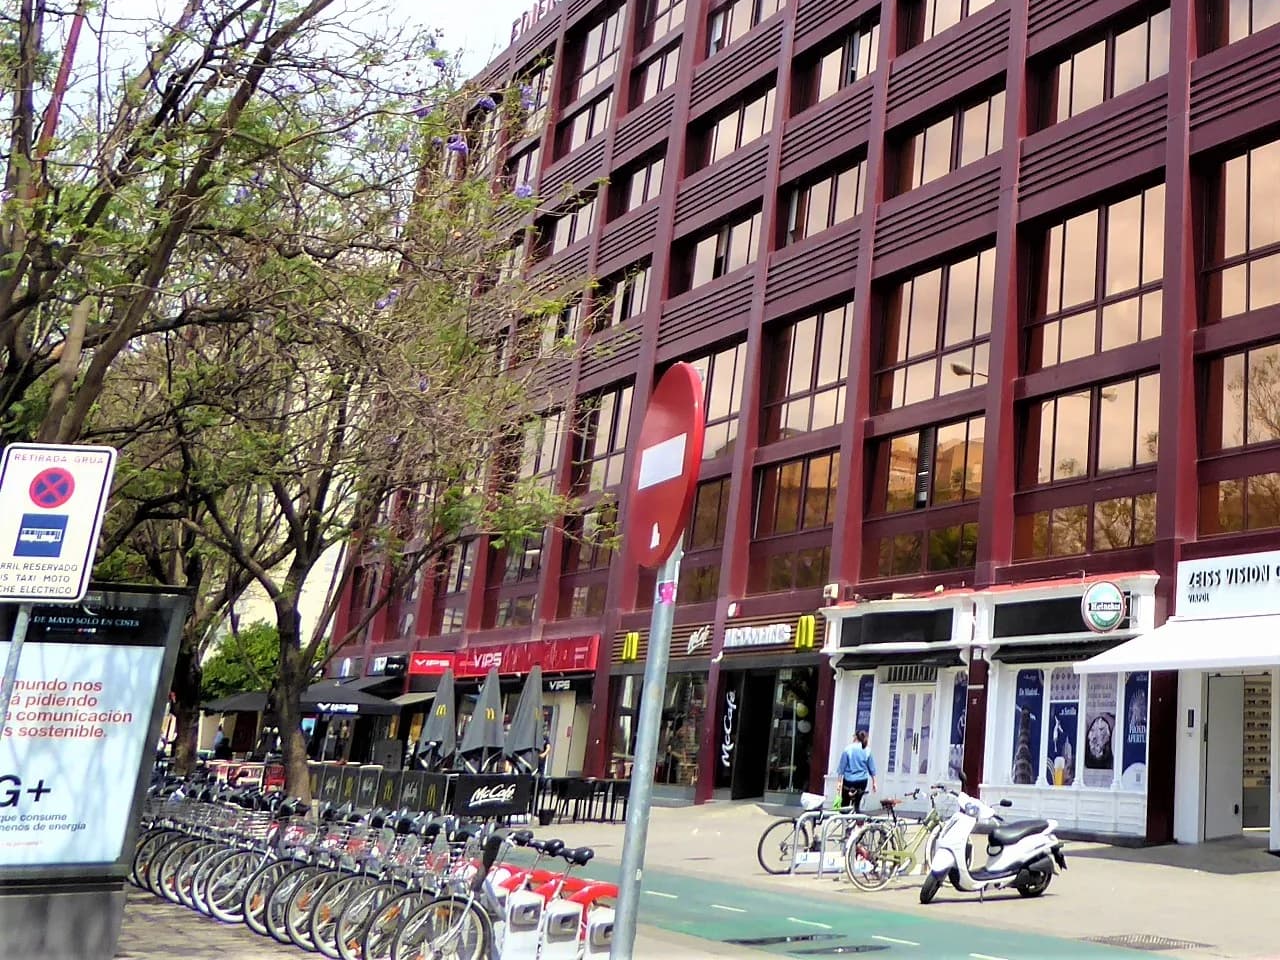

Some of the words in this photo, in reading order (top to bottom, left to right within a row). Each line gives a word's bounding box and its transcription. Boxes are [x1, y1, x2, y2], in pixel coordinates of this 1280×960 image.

[14, 453, 67, 463] RETIRADA
[74, 455, 104, 464] GRUA
[22, 561, 78, 572] RESERVADO
[16, 573, 37, 582] TAXI
[43, 574, 70, 583] MOTO
[1189, 569, 1222, 589] ZEISS
[1226, 563, 1271, 585] VISION
[20, 585, 72, 594] ELECTRICO
[48, 616, 74, 624] MAYO
[414, 658, 451, 667] VIPS
[473, 651, 503, 668] VIPS
[14, 678, 68, 691] mundo
[72, 681, 103, 692] nos
[549, 679, 571, 691] VIPS
[25, 693, 98, 708] pidiendo
[16, 710, 133, 723] comunicación
[18, 724, 107, 738] sostenible.
[20, 813, 68, 822] consume
[33, 821, 46, 831] de
[48, 820, 87, 833] energía
